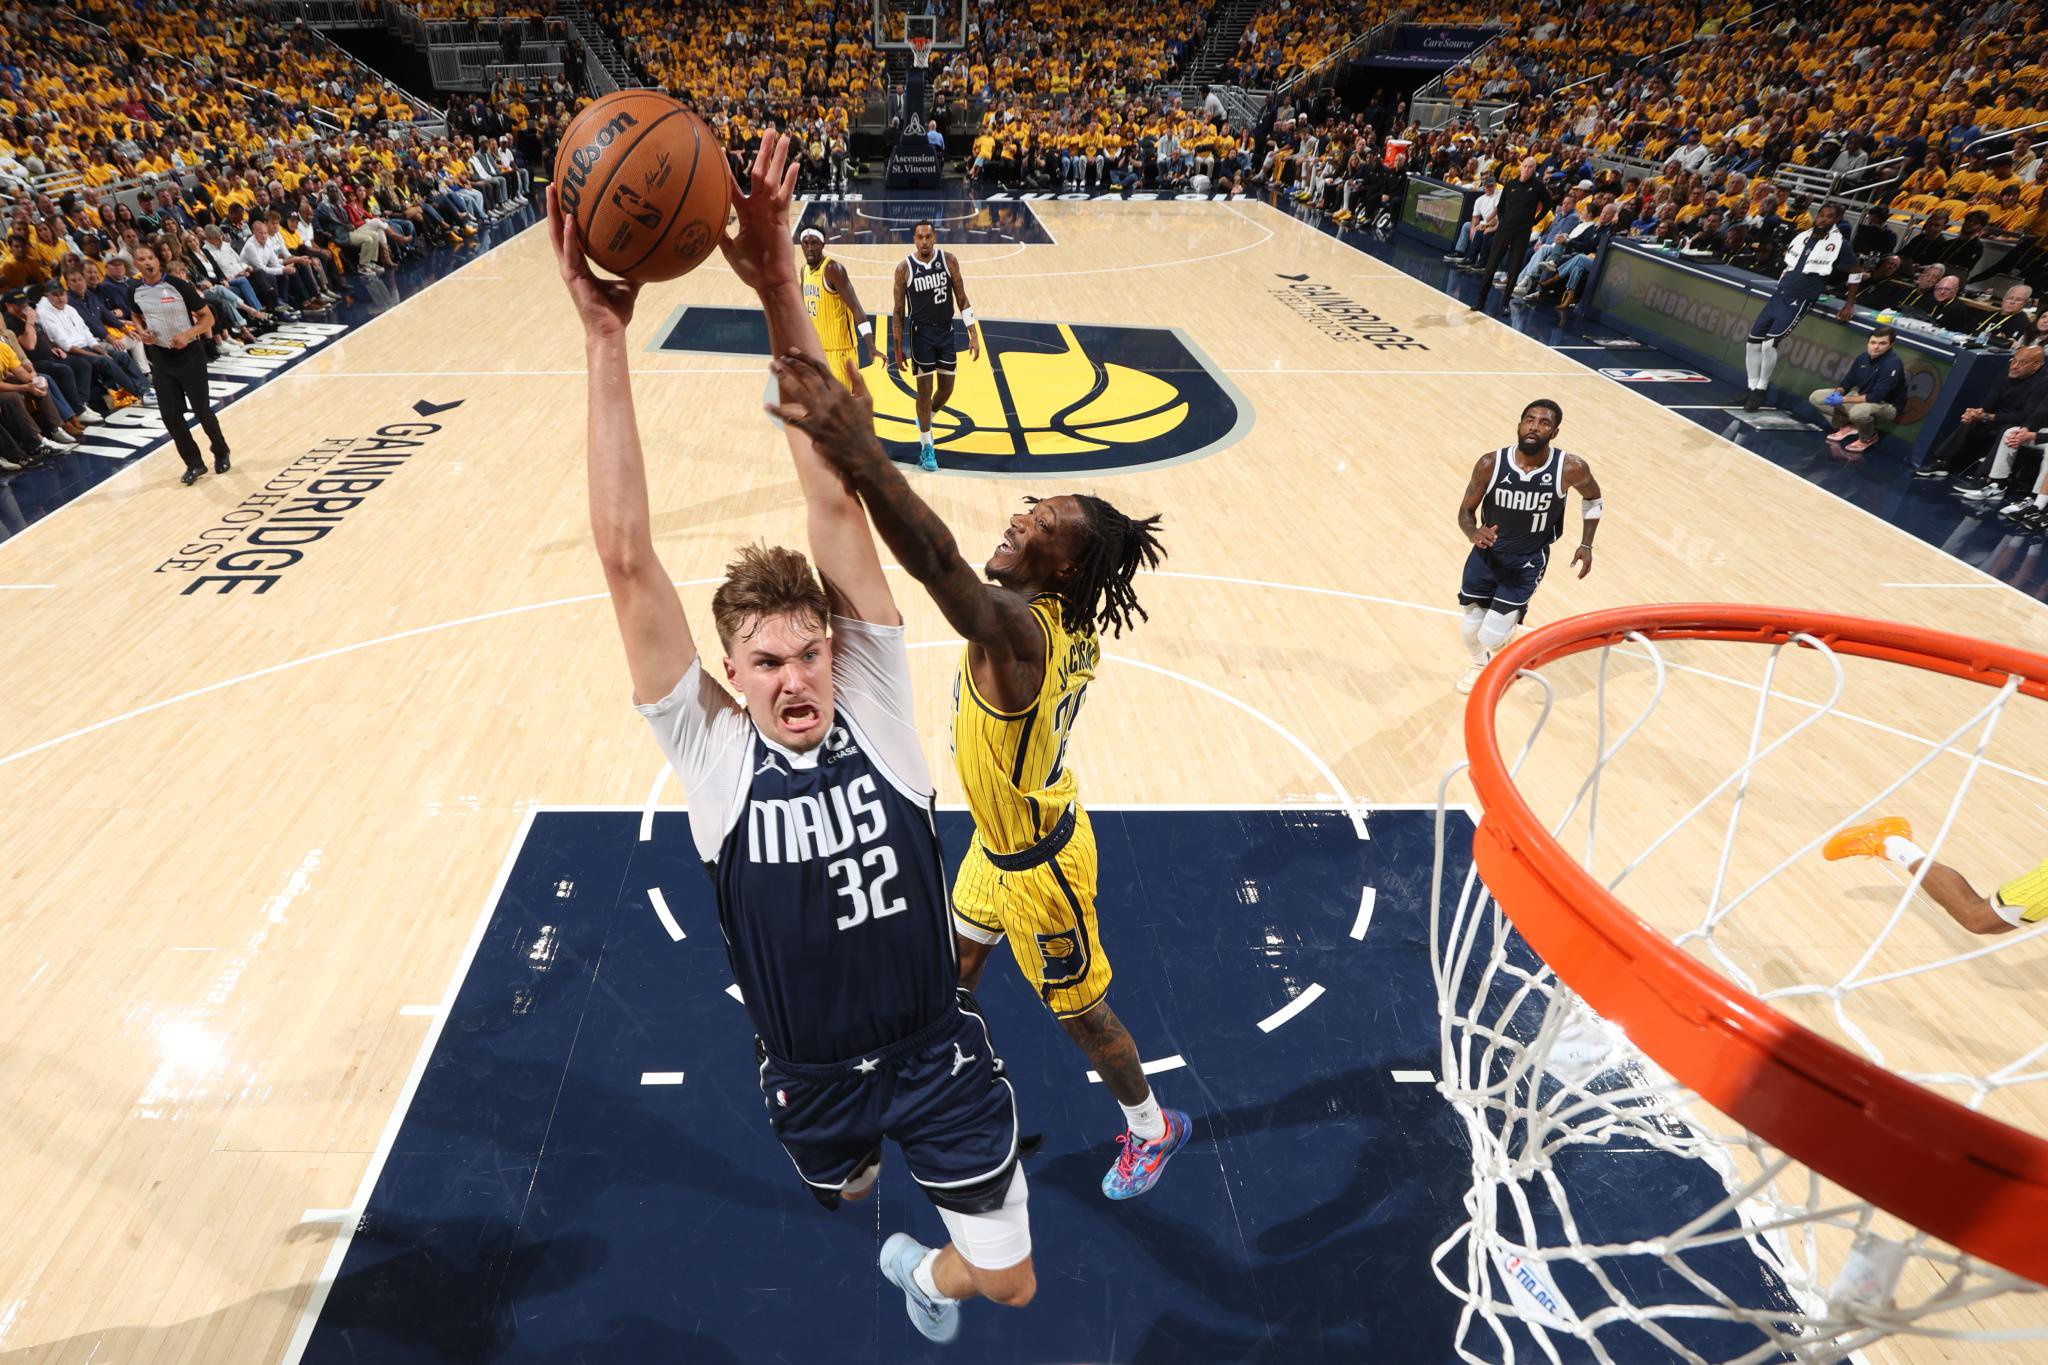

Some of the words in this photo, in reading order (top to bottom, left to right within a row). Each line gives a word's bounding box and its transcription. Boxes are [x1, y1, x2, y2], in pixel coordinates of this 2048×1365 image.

[1423, 37, 1474, 48] CareSource
[560, 111, 640, 212] Wilson
[892, 153, 936, 163] Ascension
[905, 164, 937, 173] Vincent
[986, 193, 1158, 201] LUCAS
[1174, 193, 1247, 201] OIL
[933, 287, 948, 304] 25
[1288, 283, 1431, 351] GAINBRIDGE
[1643, 283, 1720, 334] EMBRACE
[153, 437, 358, 573] FIELDHOUSE
[180, 422, 442, 595] GAINBRIDGE
[1530, 511, 1548, 533] 11
[827, 745, 858, 764] CHASE
[828, 845, 908, 931] 32
